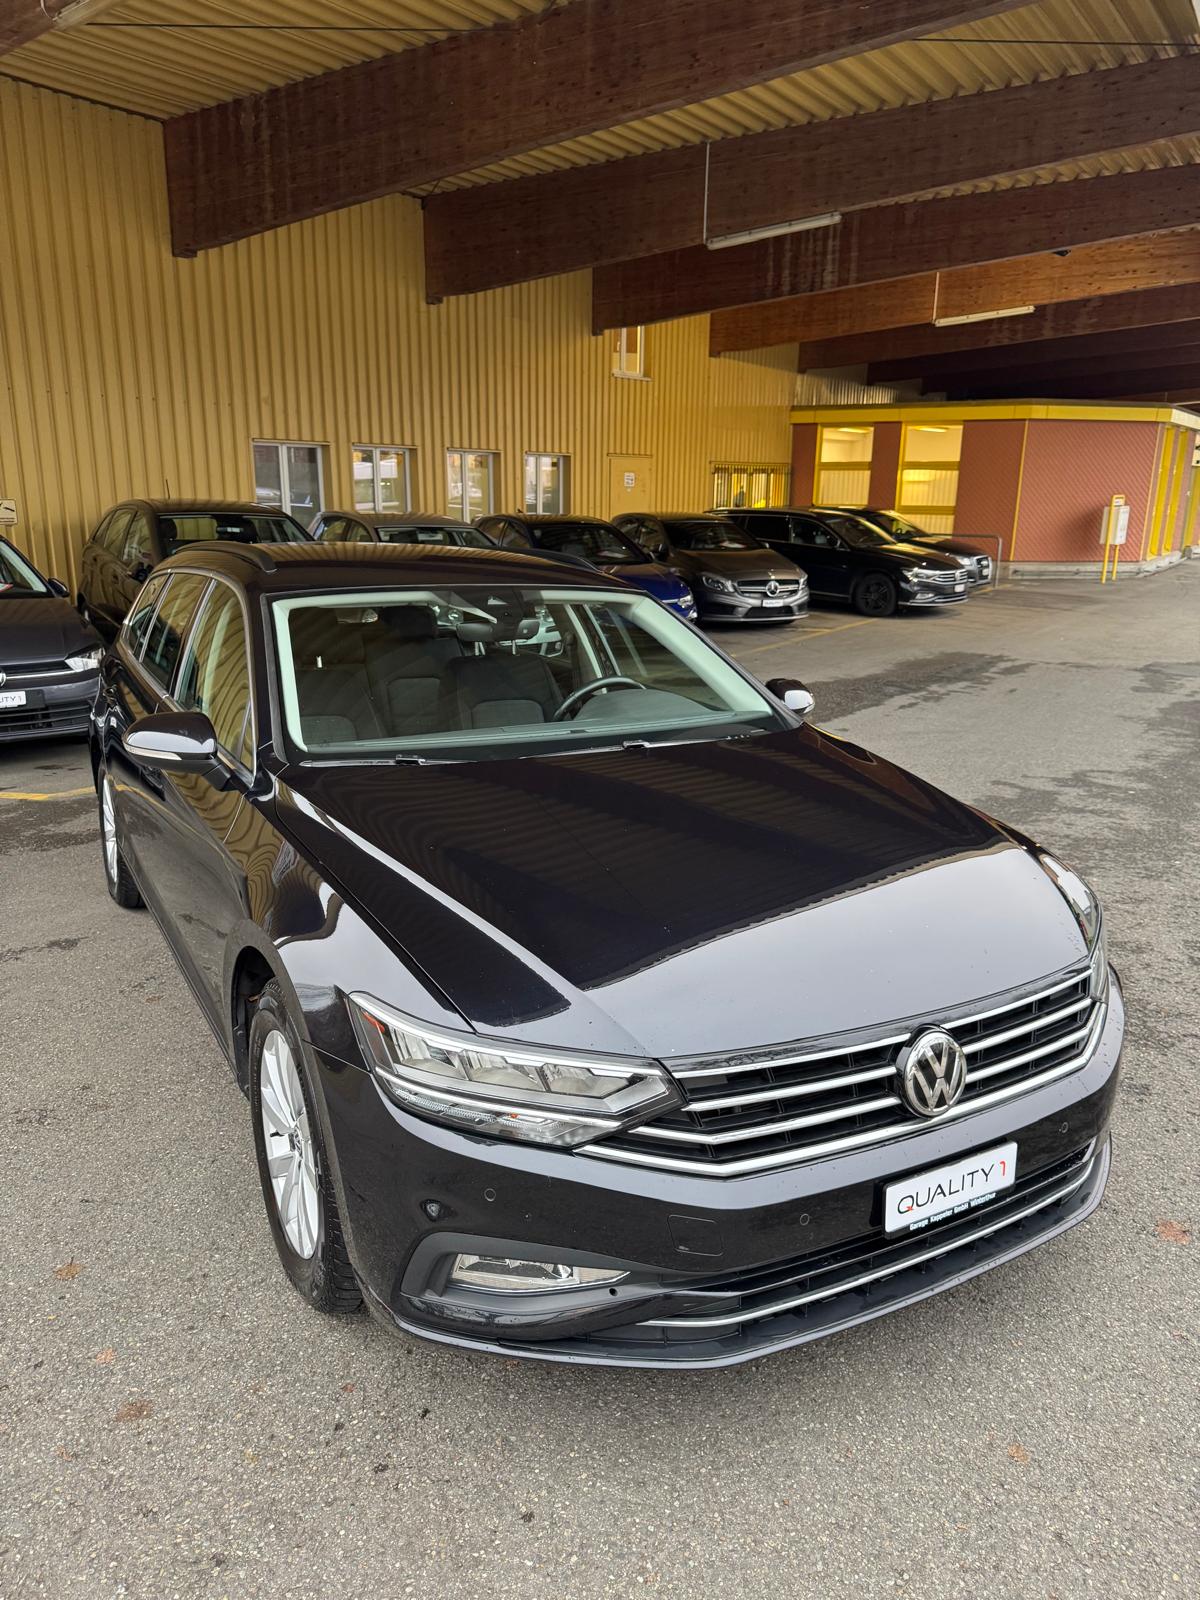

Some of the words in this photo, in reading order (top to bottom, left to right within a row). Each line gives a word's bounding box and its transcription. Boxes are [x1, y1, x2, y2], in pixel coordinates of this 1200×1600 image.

[906, 1030, 966, 1117] VW
[897, 1163, 995, 1215] QUALITY
[999, 1160, 1006, 1177] 1
[909, 1218, 929, 1231] Garage
[953, 1202, 969, 1214] GmbH
